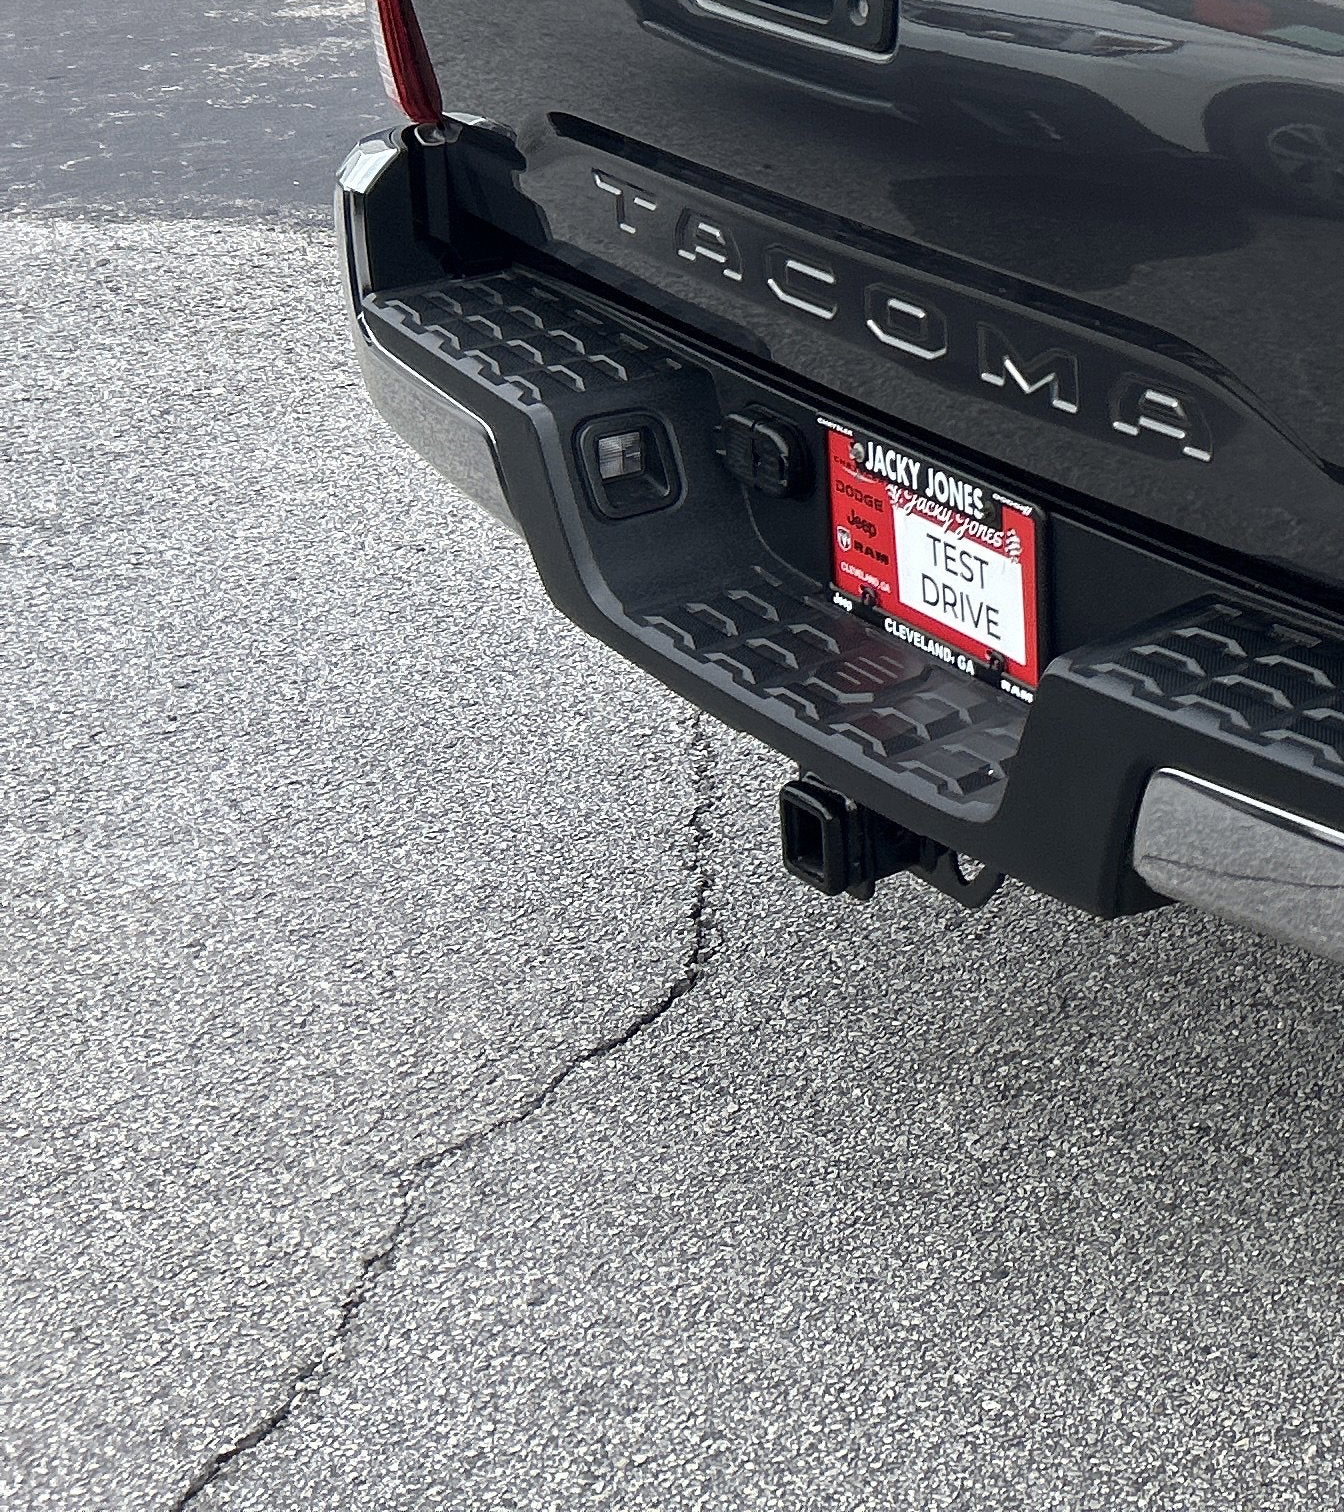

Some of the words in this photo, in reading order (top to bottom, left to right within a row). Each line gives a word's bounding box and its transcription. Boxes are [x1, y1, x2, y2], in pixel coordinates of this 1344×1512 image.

[592, 167, 1213, 461] TACOMA
[835, 479, 884, 513] DODGE
[865, 441, 921, 490] JACKY
[925, 467, 985, 520] JONES
[853, 539, 889, 566] RAM
[926, 532, 989, 590] TEST
[921, 573, 1002, 641] DRIVE
[884, 617, 955, 665] CLEVELAND,
[956, 655, 976, 676] GA
[1001, 679, 1034, 704] RAM
